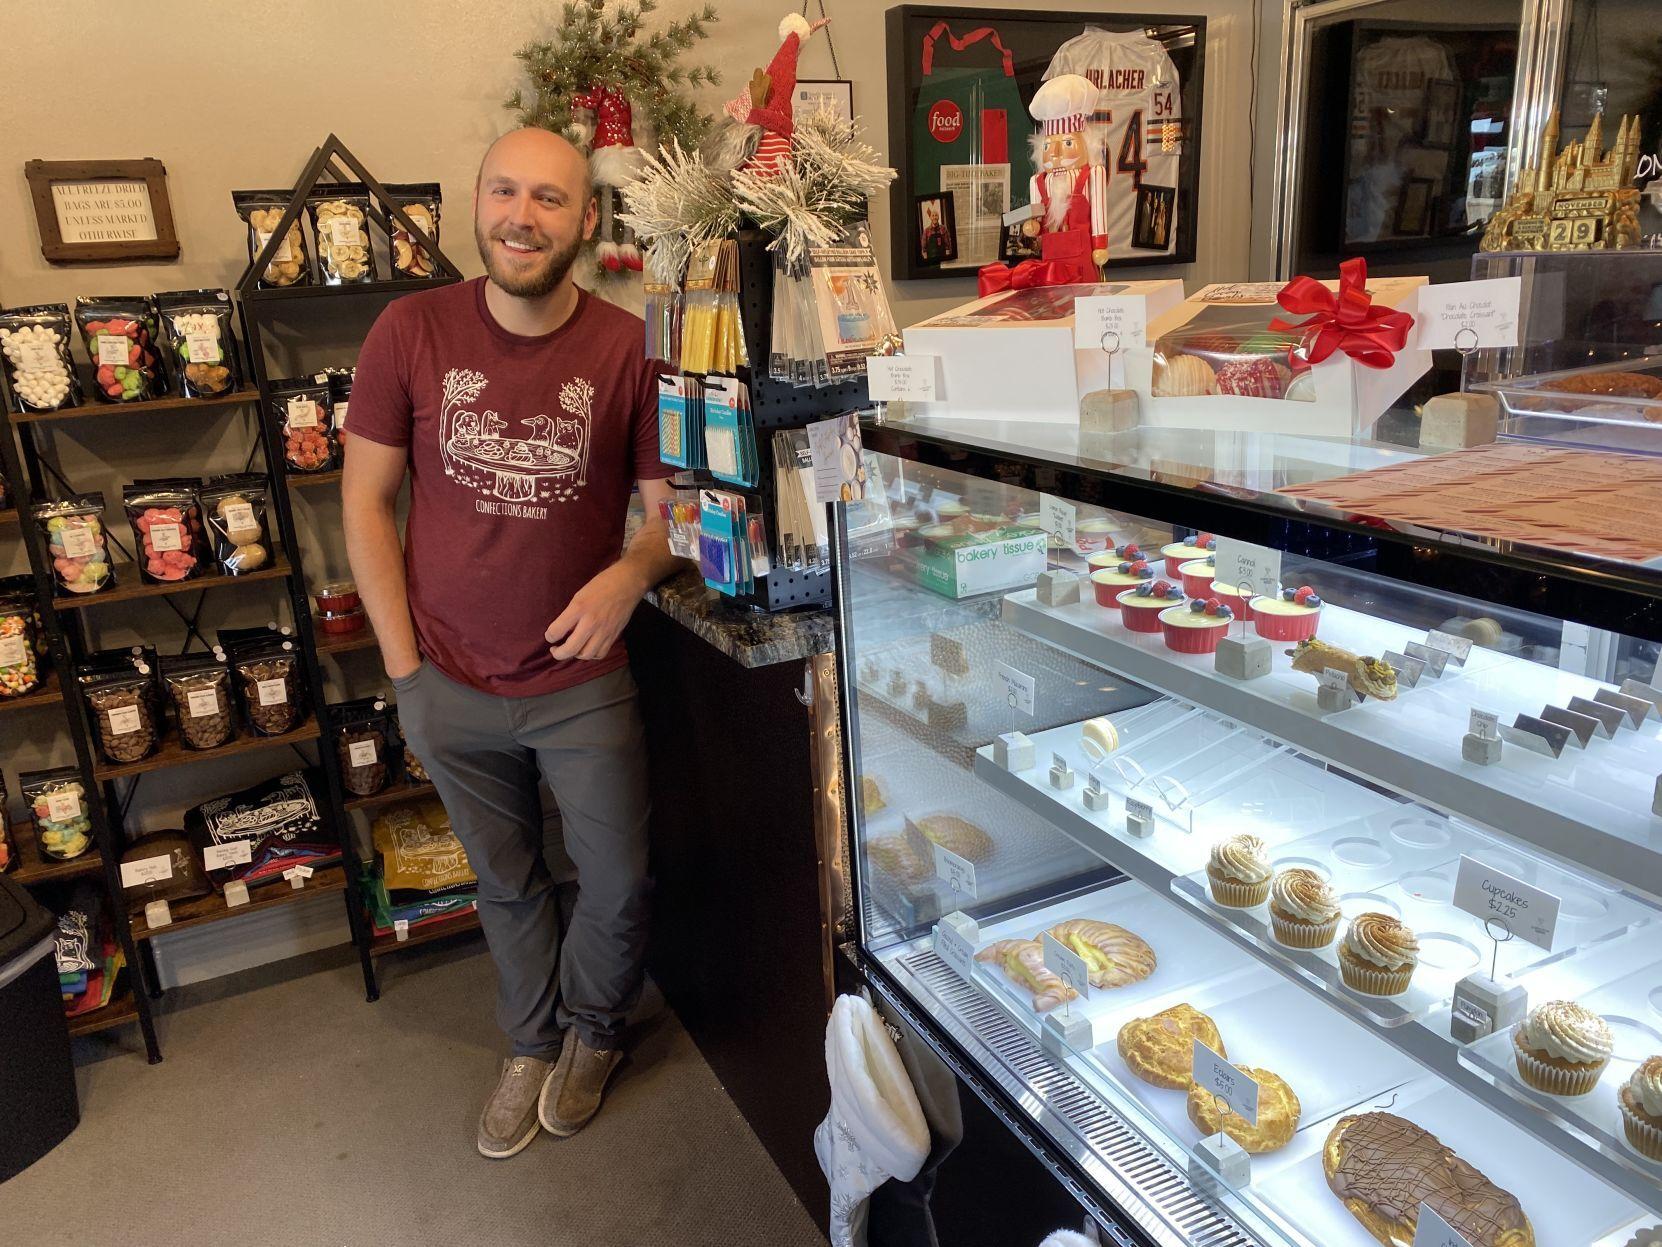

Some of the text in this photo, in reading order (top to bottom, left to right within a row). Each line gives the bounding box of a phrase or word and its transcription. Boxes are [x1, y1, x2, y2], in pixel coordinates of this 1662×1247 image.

[1154, 92, 1172, 116] 54
[932, 111, 960, 132] food
[77, 184, 112, 195] FREEZE
[115, 183, 146, 194] DRIED
[64, 200, 91, 210] BAGS
[94, 200, 111, 210] ARE
[1558, 201, 1604, 209] NOVEMBER
[65, 214, 148, 226] UNLESS MARKED
[79, 229, 137, 241] OTHERWISE
[1554, 223, 1567, 242] 2
[1576, 222, 1590, 240] 9
[475, 499, 548, 520] CONFECTIONS BAKERY
[957, 541, 1034, 563] bakery tissue
[1481, 879, 1528, 909] Cupcakes
[1487, 897, 1516, 920] $2.25
[1213, 1064, 1235, 1086] Eclairs
